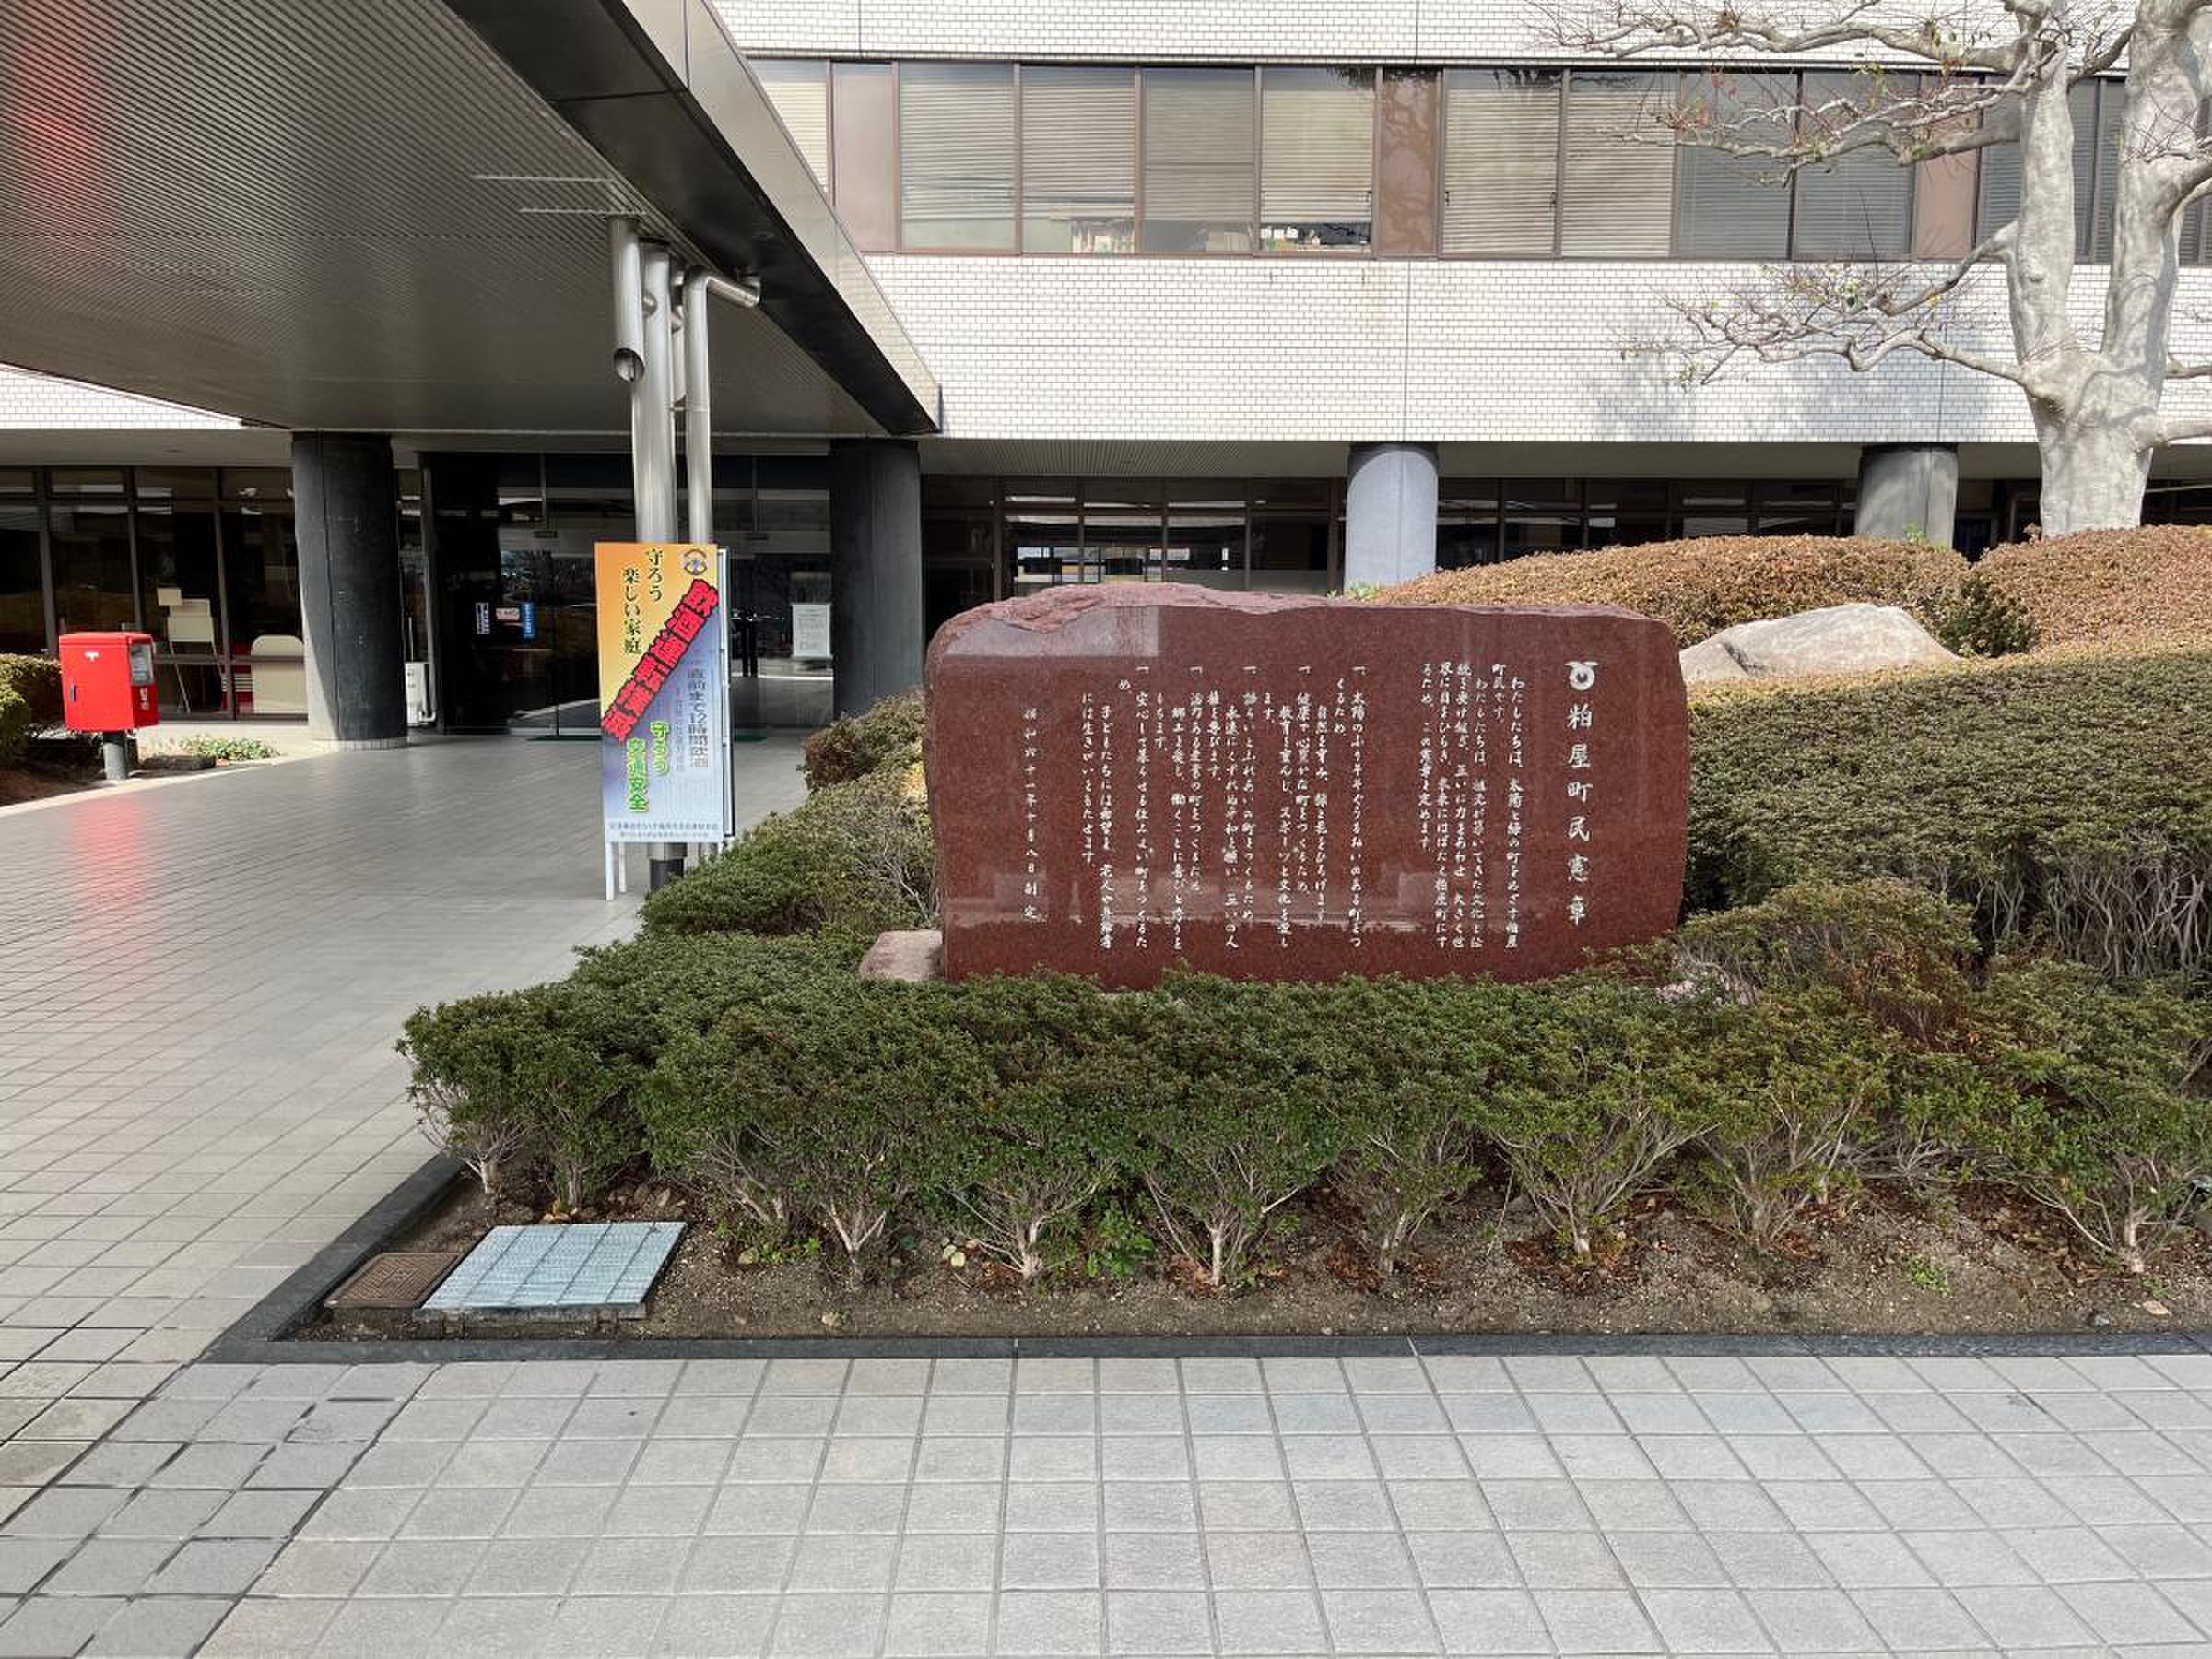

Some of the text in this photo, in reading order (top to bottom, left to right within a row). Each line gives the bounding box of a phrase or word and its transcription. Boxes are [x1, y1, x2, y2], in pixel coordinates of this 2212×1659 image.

[622, 567, 642, 655] 楽しい家庭
[646, 548, 664, 602] 守ろう
[1566, 702, 1594, 927] 粕屋町民憲章
